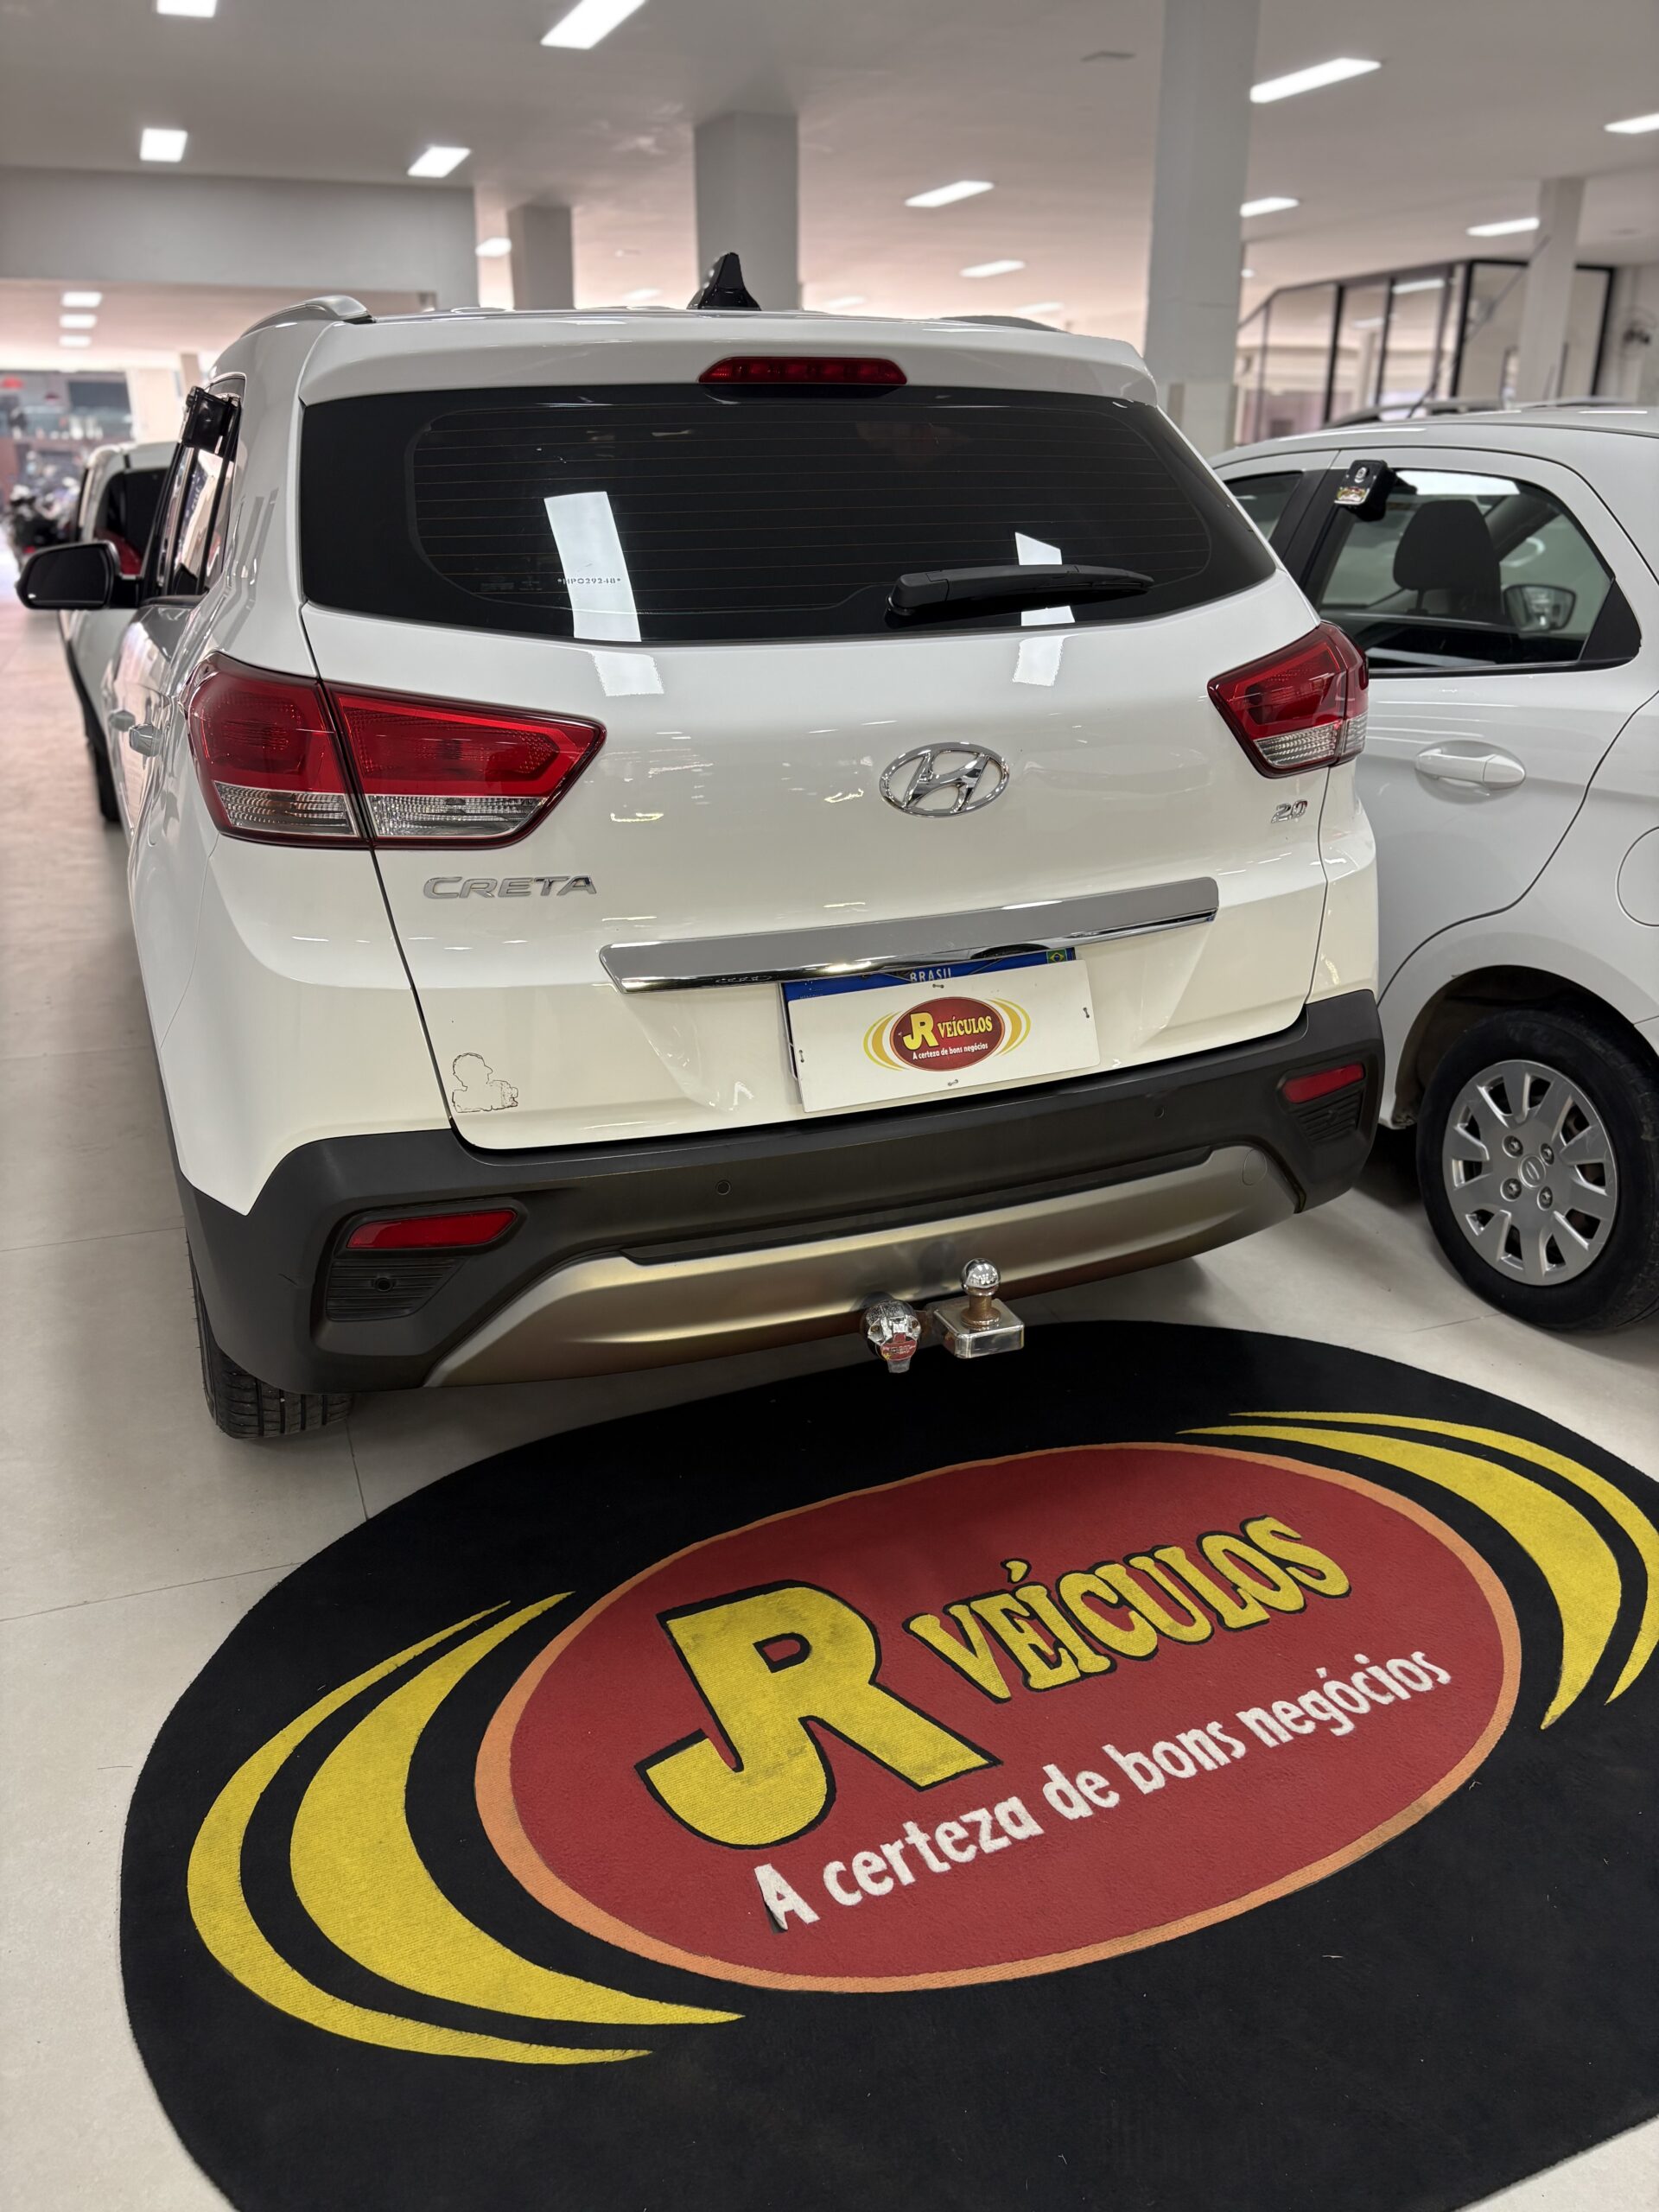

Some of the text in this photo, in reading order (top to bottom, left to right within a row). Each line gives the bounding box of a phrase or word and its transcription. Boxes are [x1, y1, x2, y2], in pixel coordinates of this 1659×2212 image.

[423, 875, 596, 899] CRETA
[902, 1012, 993, 1050] JR VEÍCULOS
[912, 1052, 918, 1060] A
[918, 1051, 940, 1059] certeza
[941, 1047, 948, 1056] de
[964, 1042, 988, 1052] negócios
[638, 1515, 1351, 1848] JR VEÍCULOS
[753, 1650, 1452, 1930] A certeza de bons negócios
